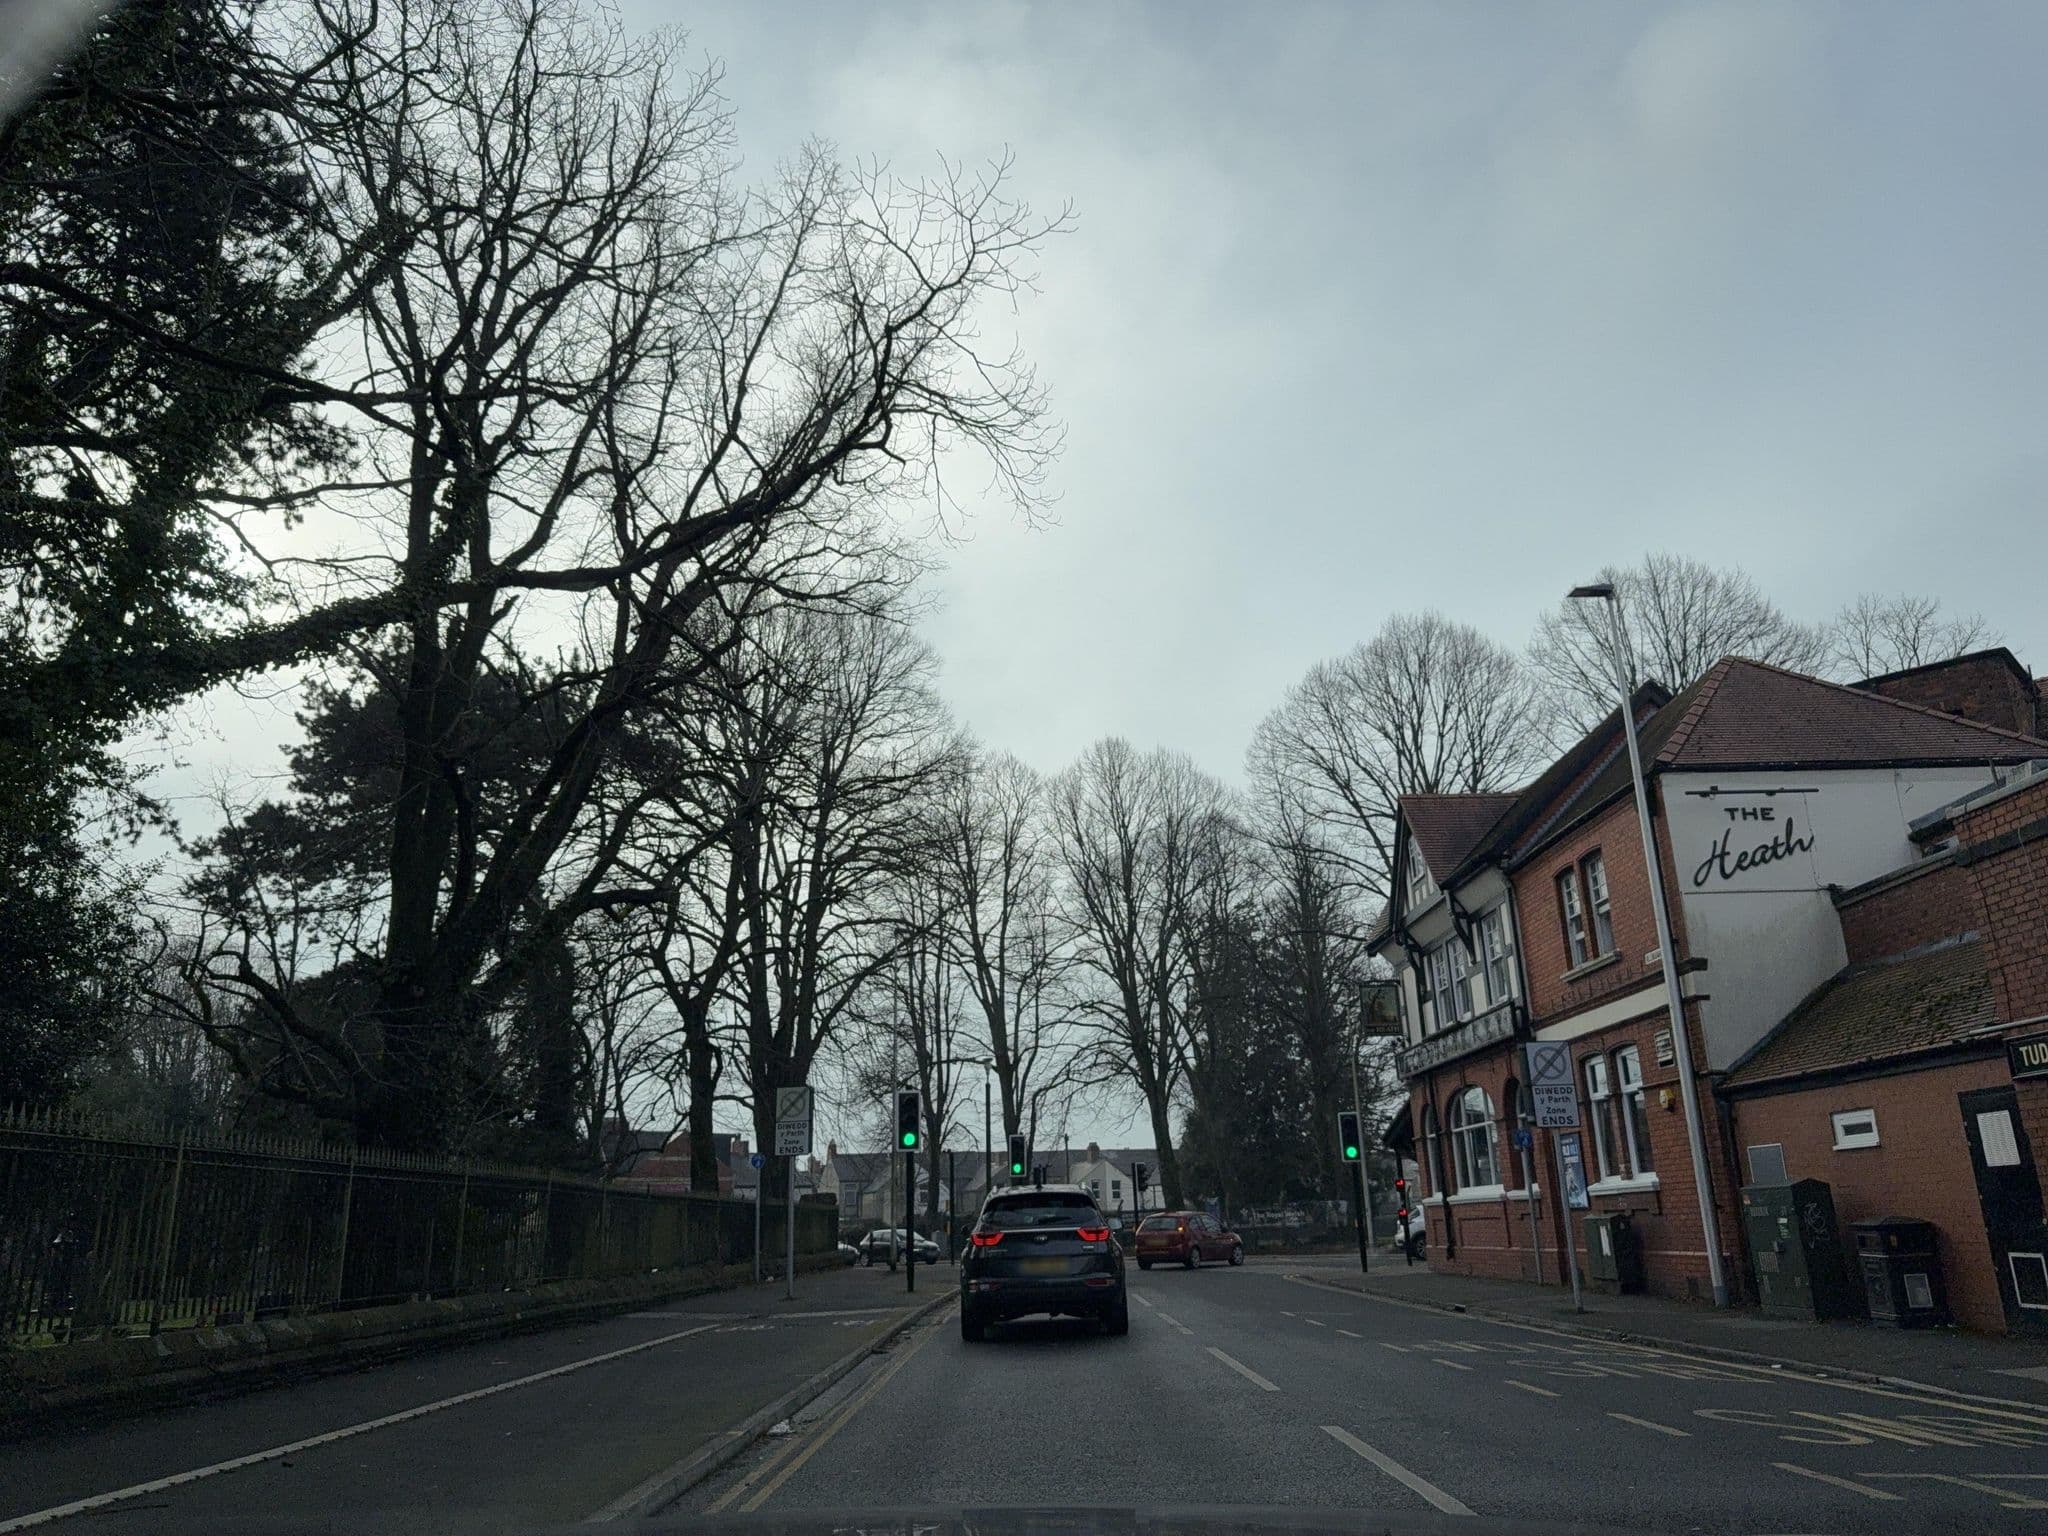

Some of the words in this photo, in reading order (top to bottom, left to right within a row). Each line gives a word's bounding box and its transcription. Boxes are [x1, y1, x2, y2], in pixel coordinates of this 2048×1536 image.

[1723, 807, 1775, 821] THE
[1693, 816, 1815, 887] Heath
[1535, 1087, 1573, 1095] DIWEDD
[1541, 1115, 1574, 1125] ENDS
[779, 1146, 804, 1154] ENDS
